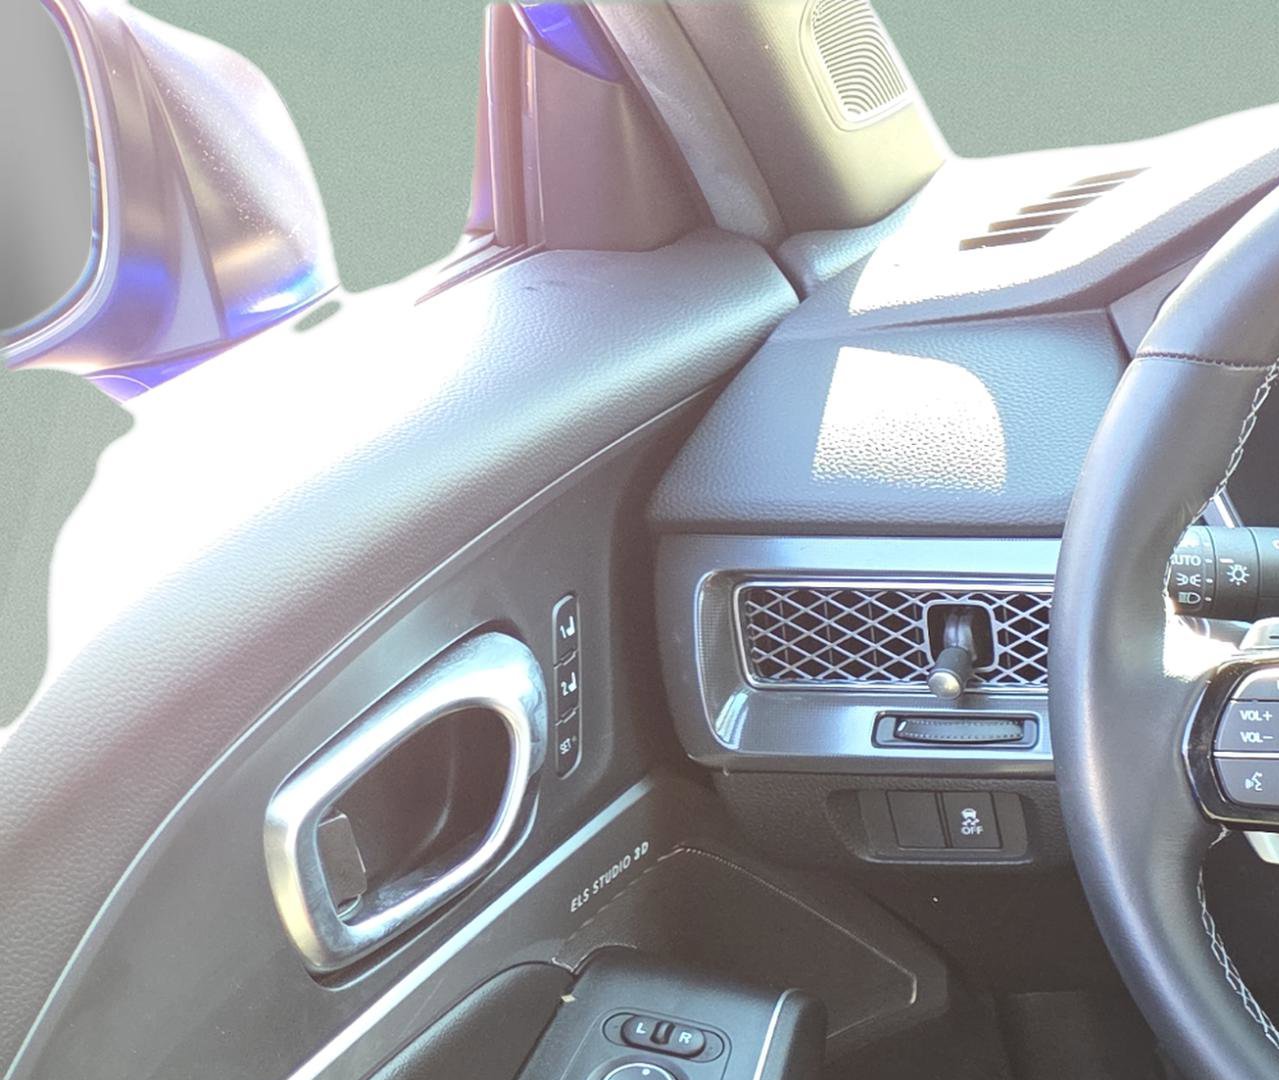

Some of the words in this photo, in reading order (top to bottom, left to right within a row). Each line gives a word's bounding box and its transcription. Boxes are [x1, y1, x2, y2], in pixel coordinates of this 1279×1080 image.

[560, 680, 570, 696] 2
[559, 738, 572, 755] SET
[961, 826, 984, 835] OFF
[570, 890, 590, 913] ELS
[593, 855, 631, 894] STUDIO
[634, 841, 650, 862] 3D
[636, 1023, 648, 1035] L
[679, 1032, 692, 1044] R
